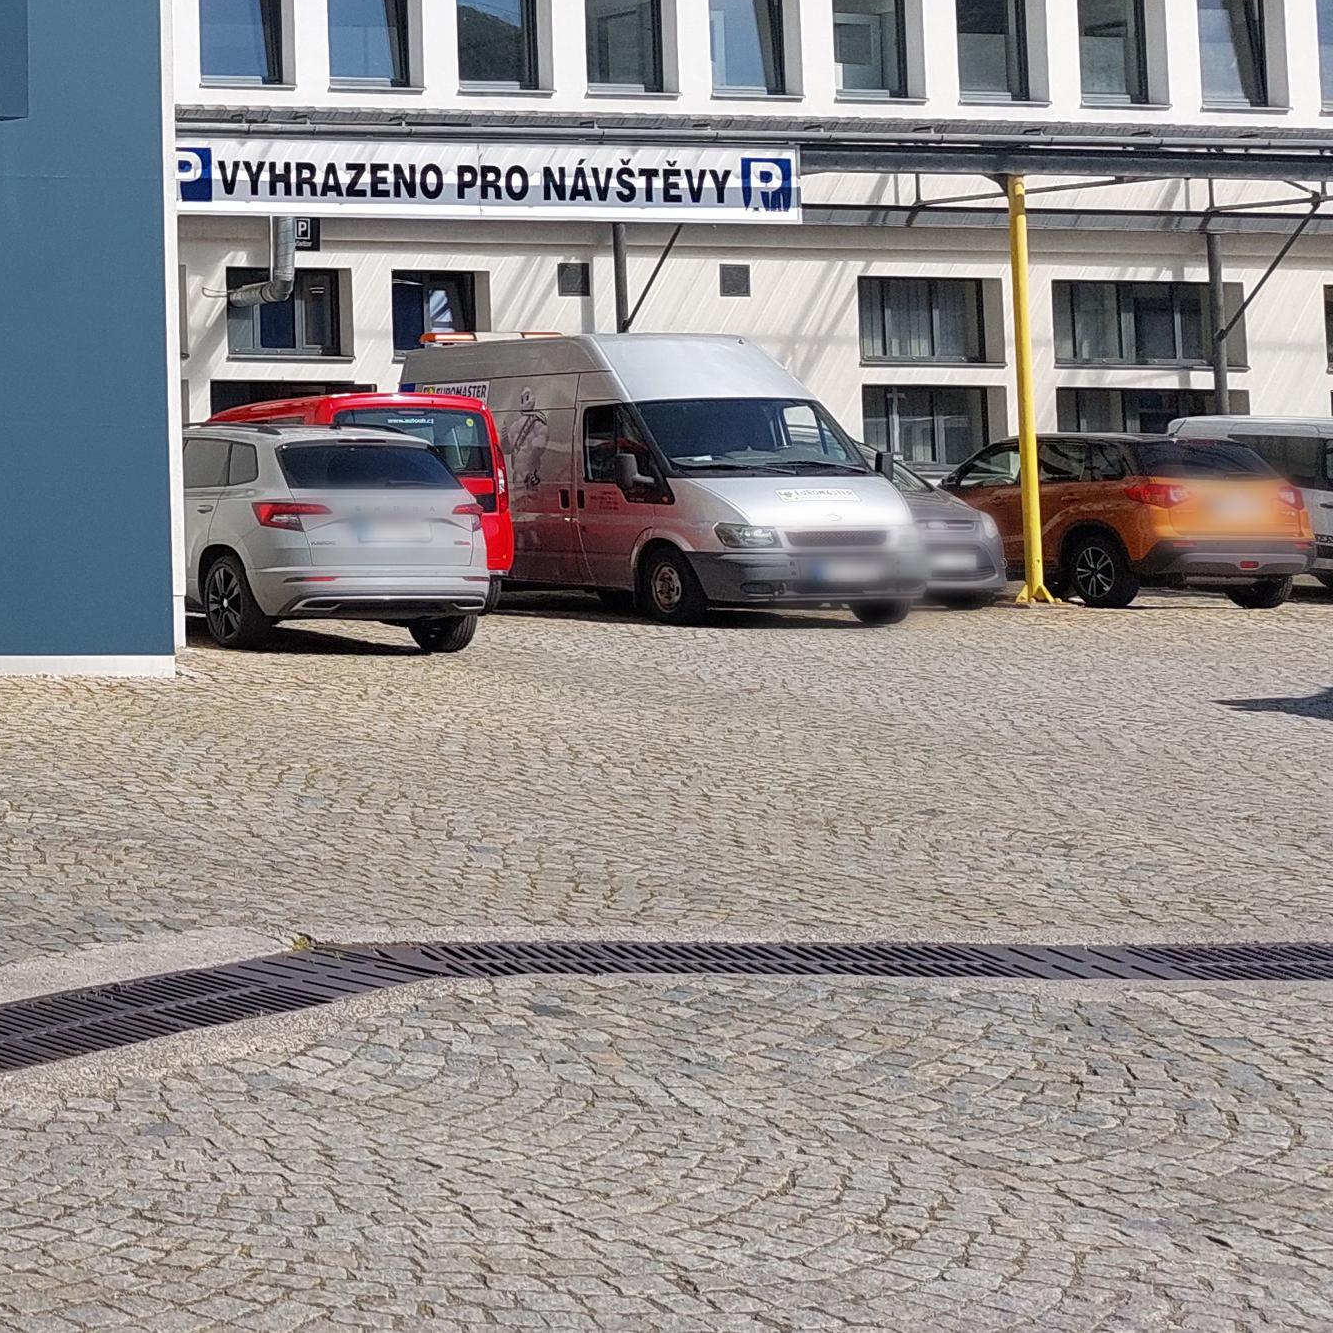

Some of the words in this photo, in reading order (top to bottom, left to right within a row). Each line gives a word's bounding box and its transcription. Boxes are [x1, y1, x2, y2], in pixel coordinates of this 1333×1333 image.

[218, 160, 444, 201] VYHRAZENO
[456, 163, 529, 202] PRO
[543, 157, 732, 205] NÁVŠTĚVY
